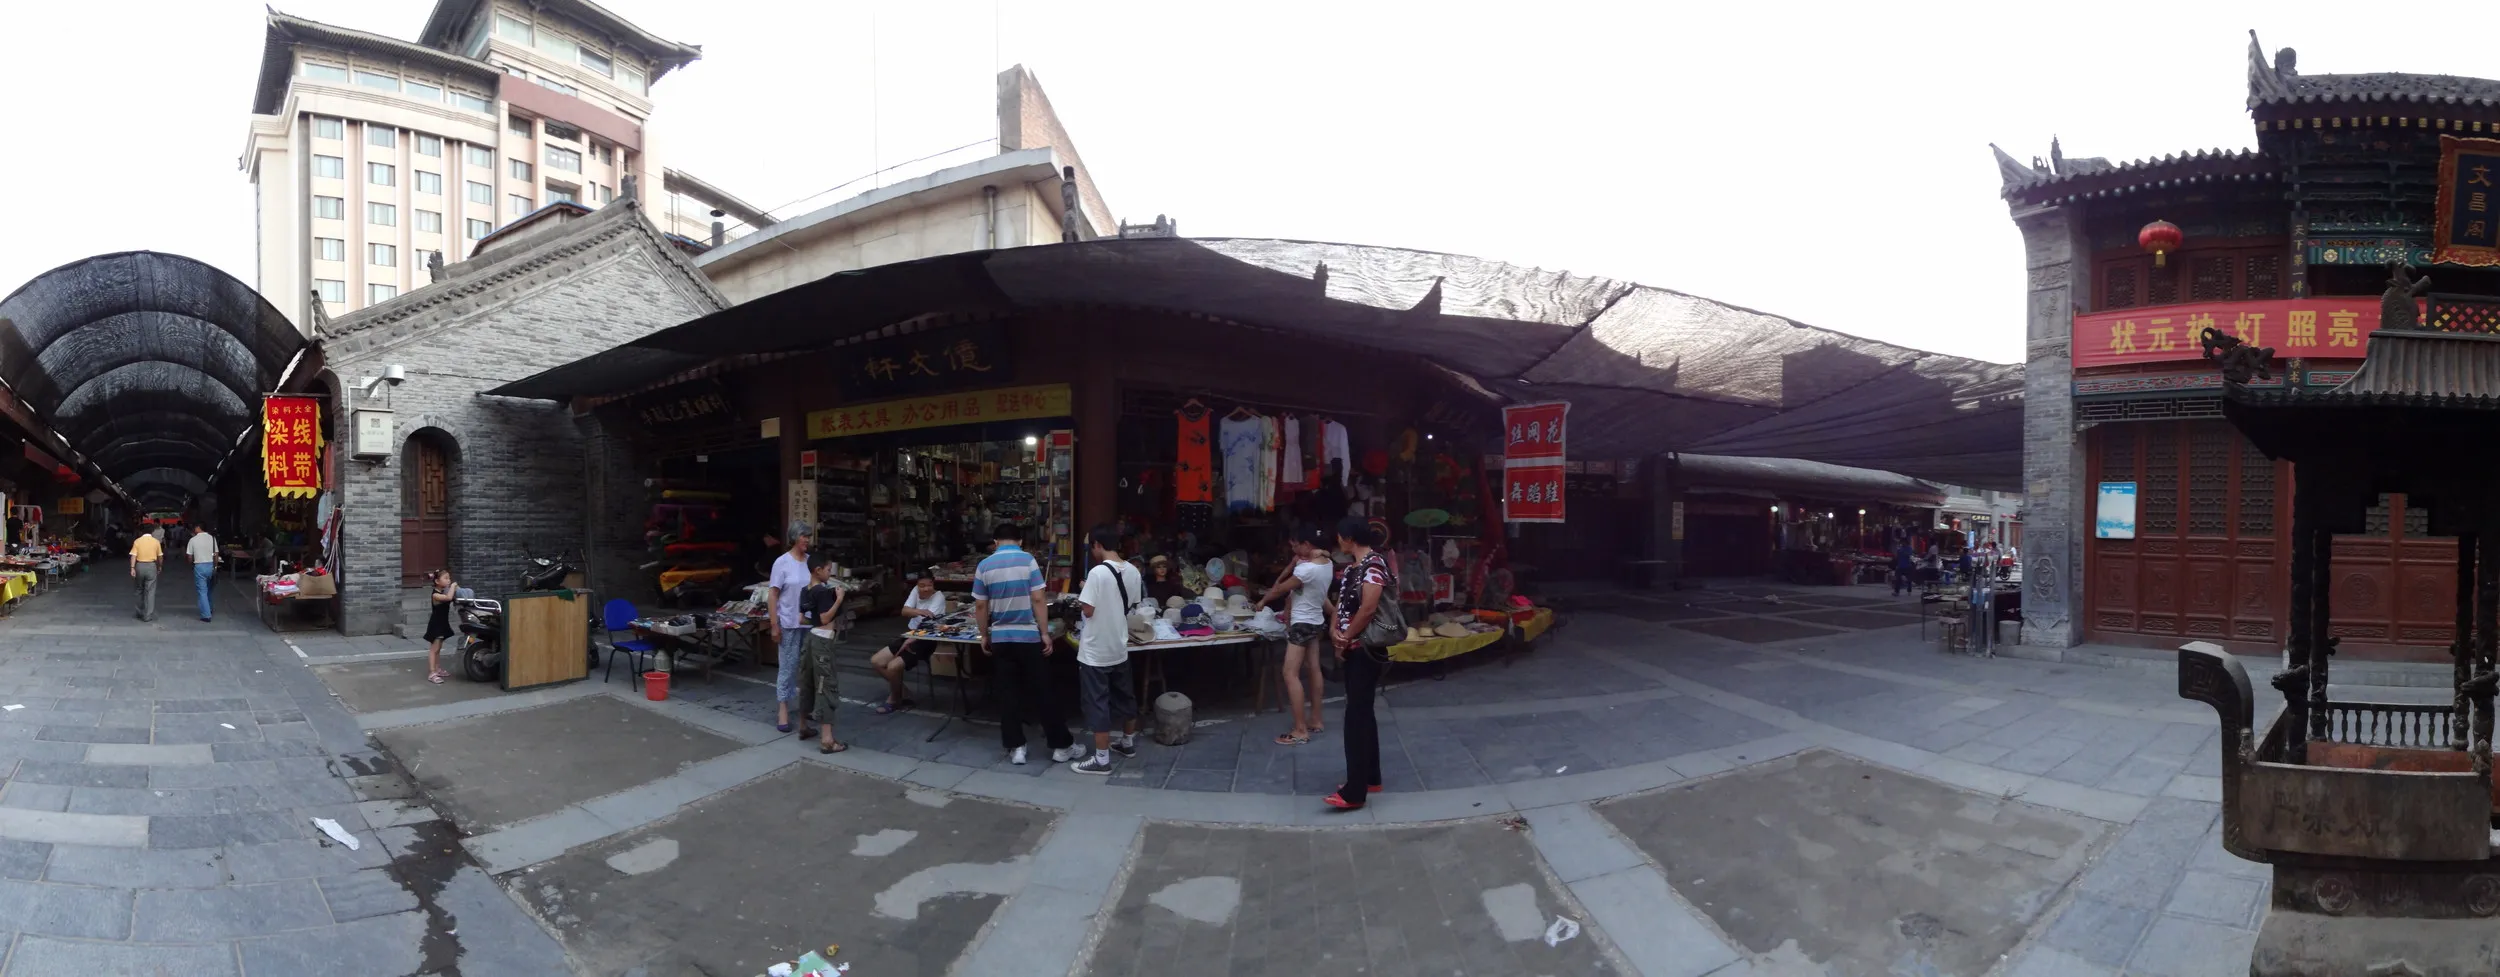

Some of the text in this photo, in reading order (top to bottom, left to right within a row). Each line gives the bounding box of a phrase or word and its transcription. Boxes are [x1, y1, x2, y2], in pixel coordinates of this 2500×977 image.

[2463, 163, 2494, 240] 文昌阁
[2109, 308, 2382, 356] 状元神灯照亮
[271, 404, 312, 415] 染料大全
[901, 397, 981, 425] 办公用品
[1509, 416, 1562, 447] 丝网花
[1509, 480, 1560, 504] 舞蹈鞋
